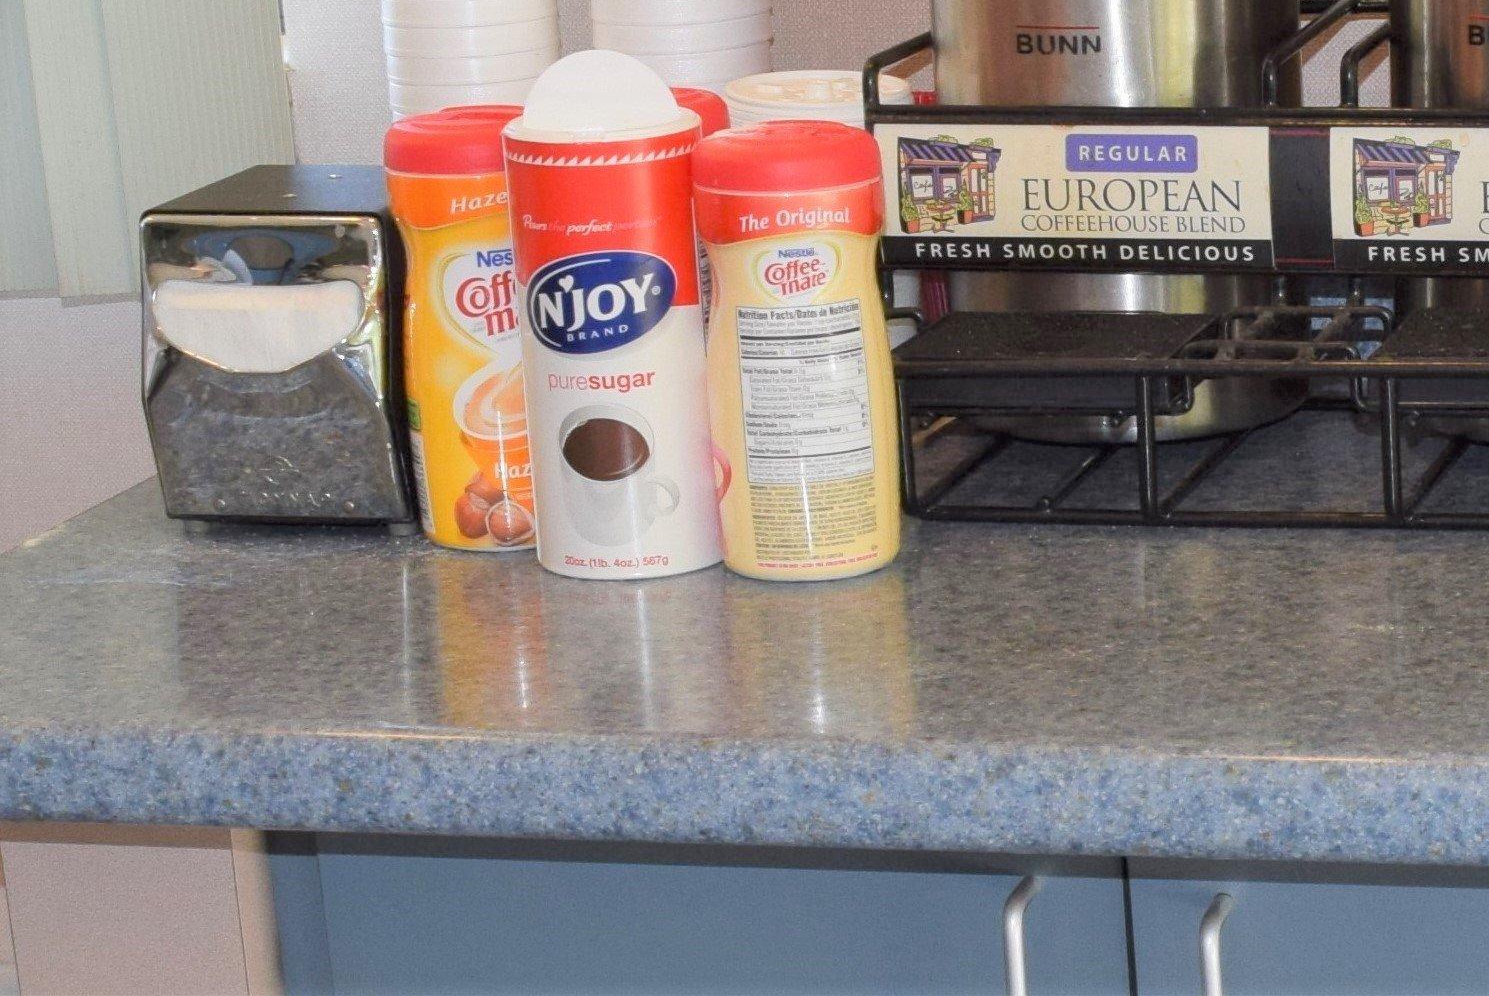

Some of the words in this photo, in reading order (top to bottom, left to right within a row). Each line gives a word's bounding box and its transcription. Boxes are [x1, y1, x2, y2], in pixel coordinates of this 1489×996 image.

[1017, 34, 1101, 55] BUNN
[1078, 145, 1187, 164] REGULAR
[1022, 178, 1243, 213] EUROPEAN
[567, 218, 613, 237] perfect
[739, 213, 770, 233] The
[776, 207, 851, 228] Original
[1021, 214, 1170, 234] COFFEEHOUSE
[1177, 215, 1246, 235] BLEND
[914, 242, 992, 261] FRESH
[1000, 242, 1107, 261] SMOOTH
[1119, 243, 1255, 262] DELICIOUS
[1368, 245, 1446, 263] FRESH
[780, 272, 827, 296] mate
[567, 324, 629, 342] BRAND
